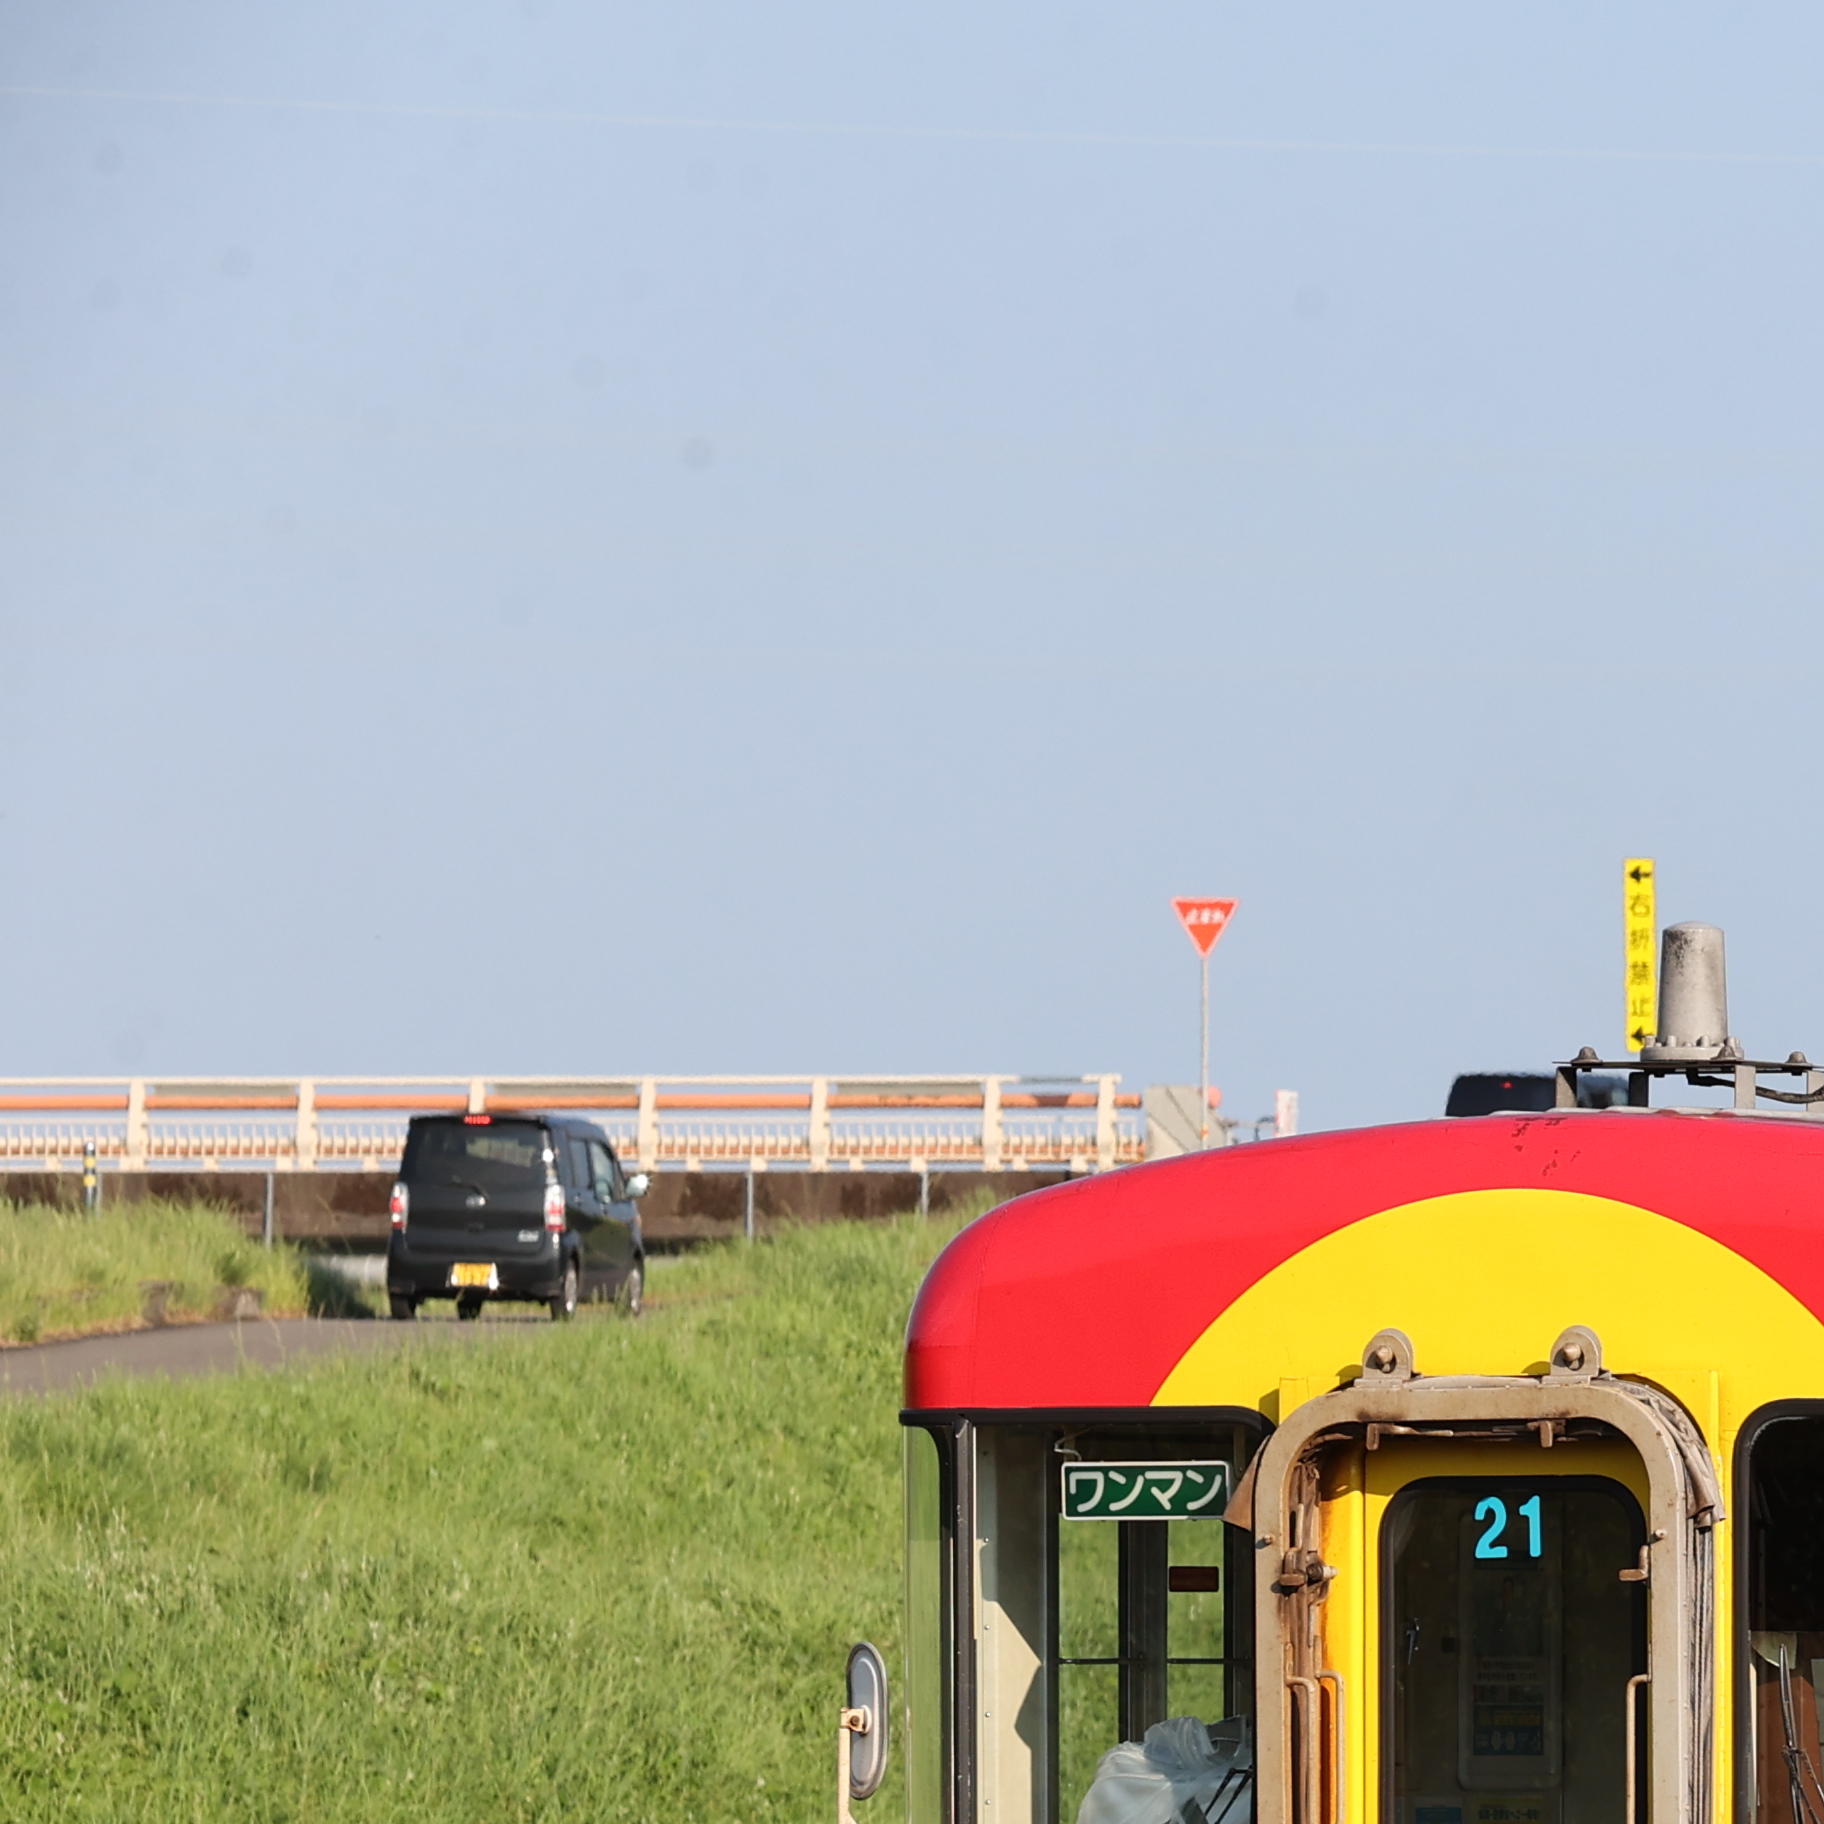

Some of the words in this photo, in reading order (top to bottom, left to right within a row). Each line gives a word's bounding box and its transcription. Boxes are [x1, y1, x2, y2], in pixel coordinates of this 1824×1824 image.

[1069, 1469, 1222, 1513] ワンマン
[1474, 1495, 1542, 1559] 21
